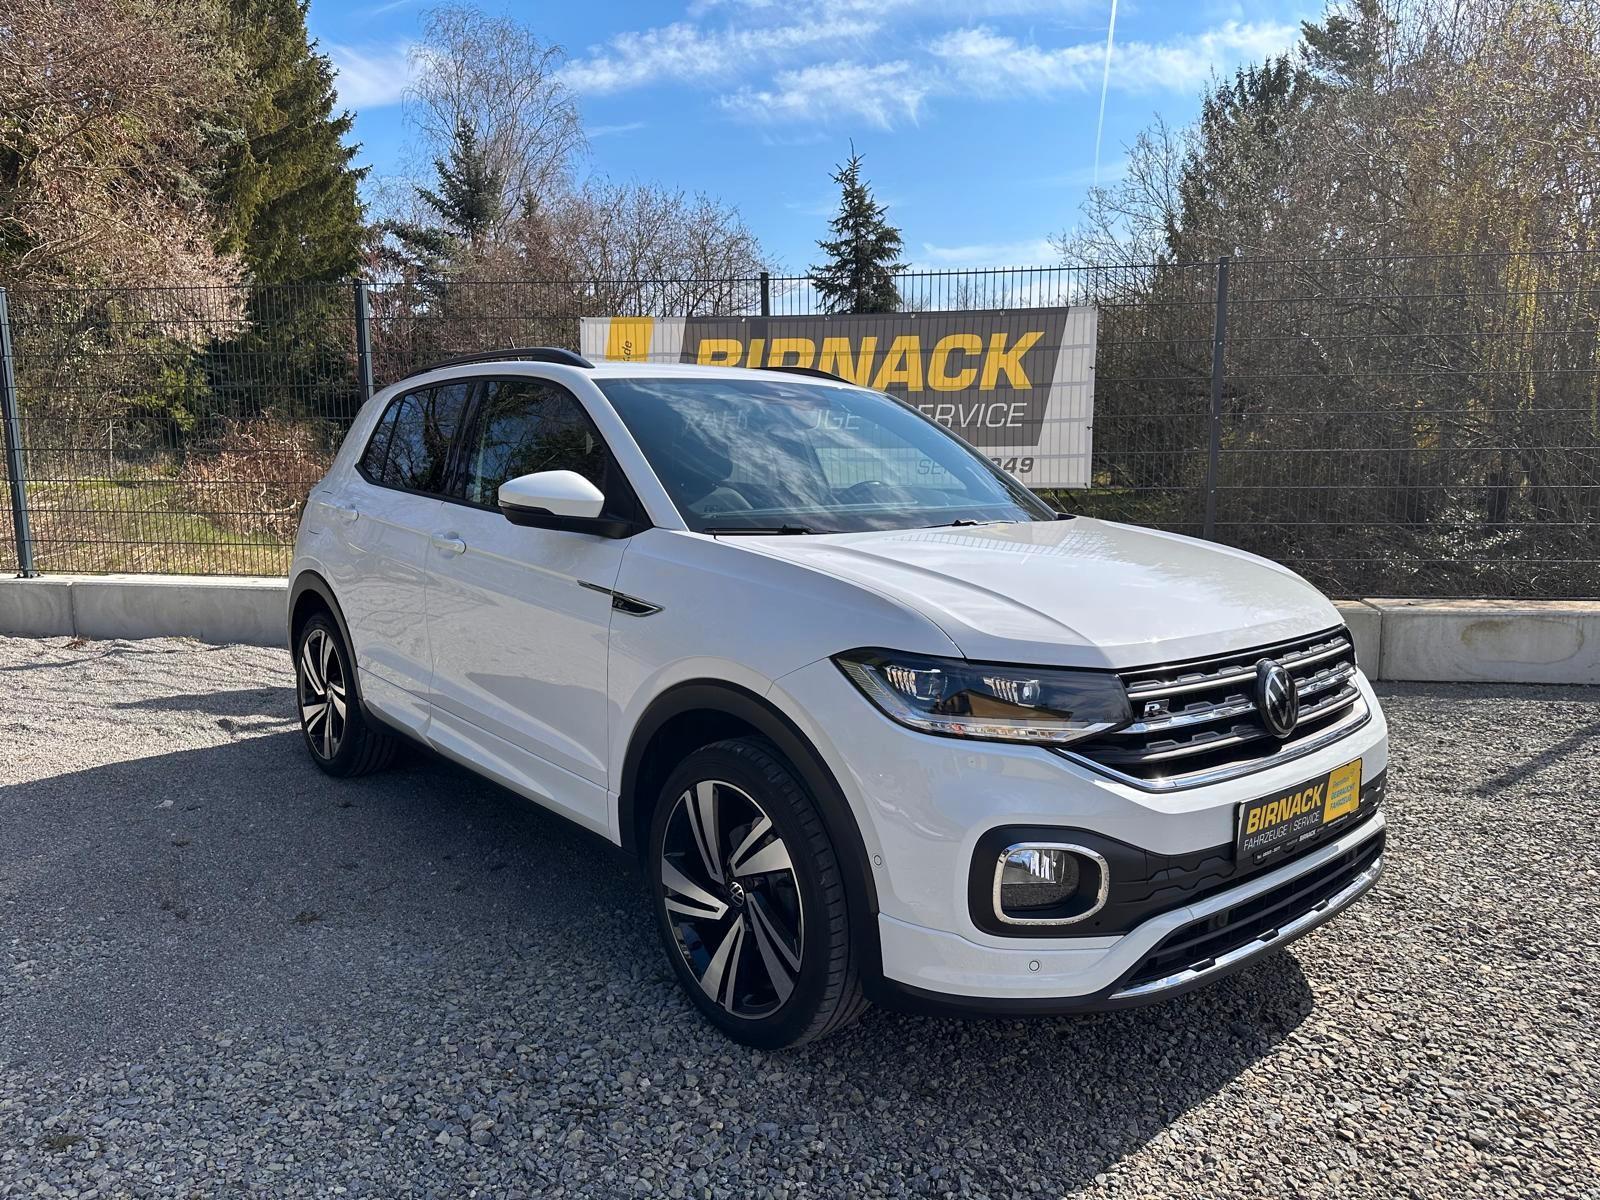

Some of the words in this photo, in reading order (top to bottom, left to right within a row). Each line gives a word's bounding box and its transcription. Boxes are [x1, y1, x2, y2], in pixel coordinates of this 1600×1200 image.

[1243, 824, 1288, 851] FAHRZEUGE
[1293, 810, 1320, 832] SERVICE
[1246, 783, 1325, 835] BIRNACK
